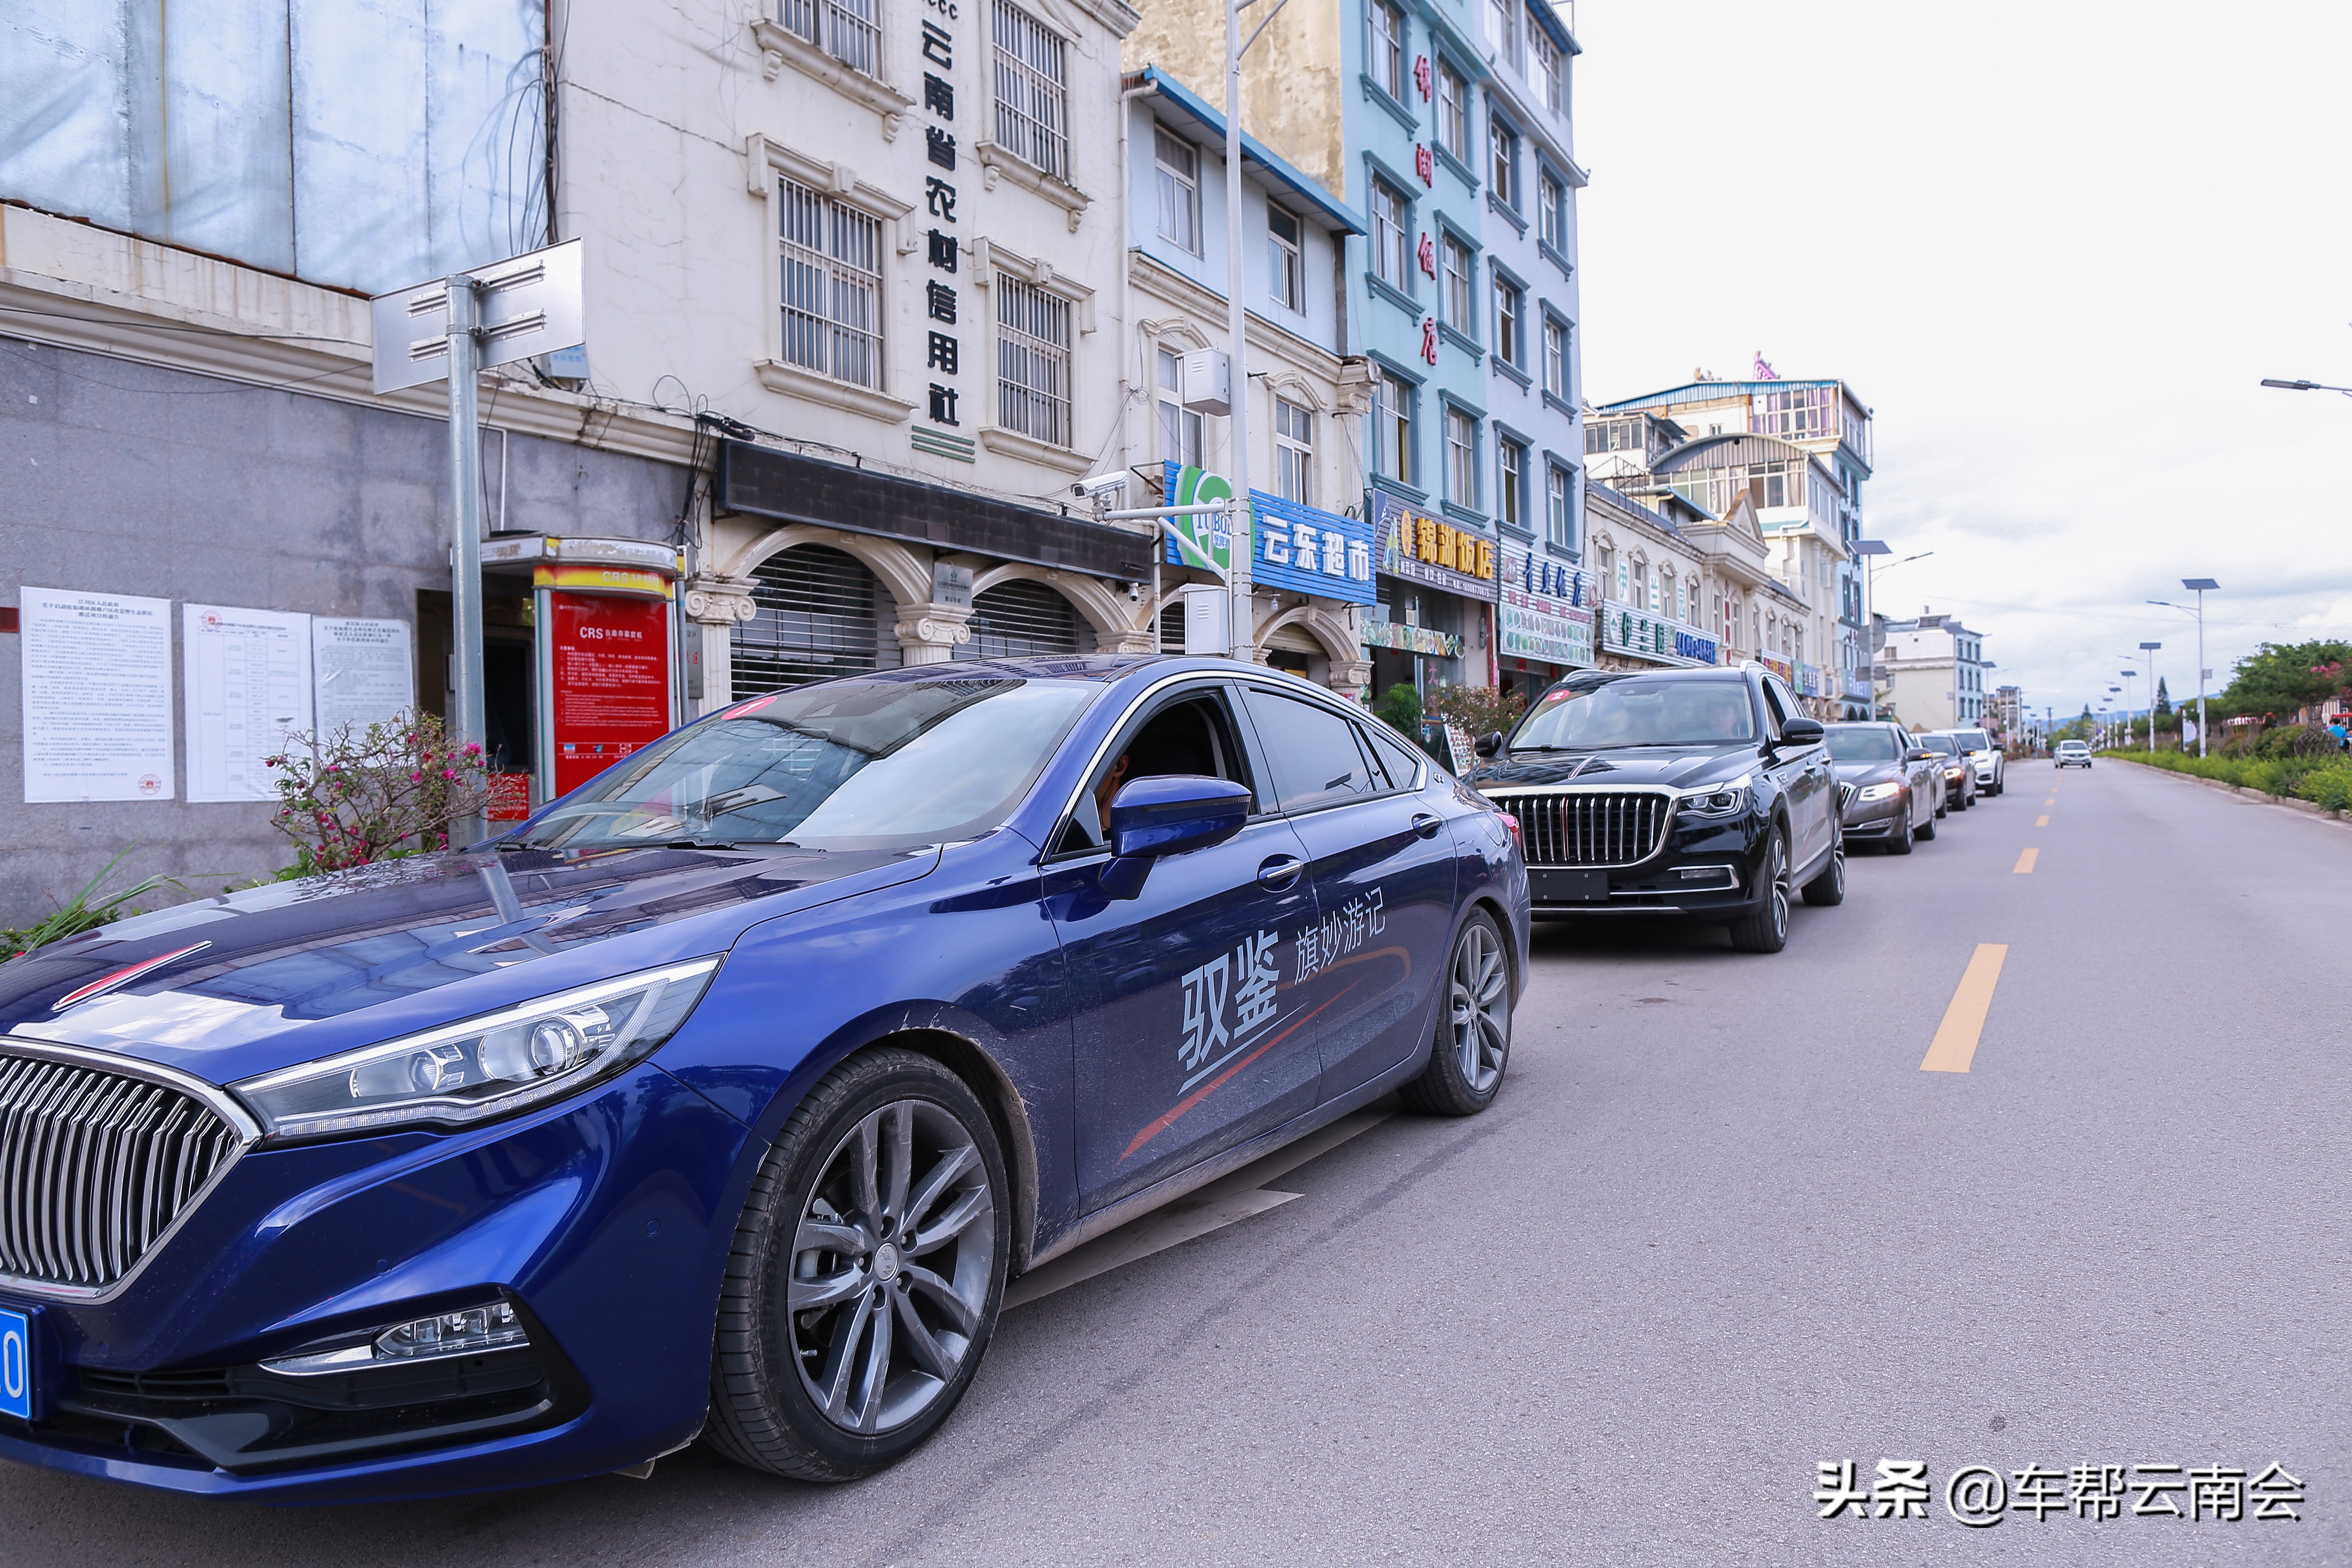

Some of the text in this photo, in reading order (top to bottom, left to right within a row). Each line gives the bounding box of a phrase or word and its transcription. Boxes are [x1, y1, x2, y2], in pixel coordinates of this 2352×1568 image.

[922, 18, 960, 426] 云南省农村信用社
[1263, 515, 1369, 581] 云东超市
[1417, 517, 1493, 580] 锦湖饭店
[602, 571, 629, 583] CRS
[580, 626, 603, 639] CRS
[734, 701, 765, 716] 1
[1551, 691, 1564, 700] 2
[1177, 886, 1386, 1071] 驭鉴 旗妙游记
